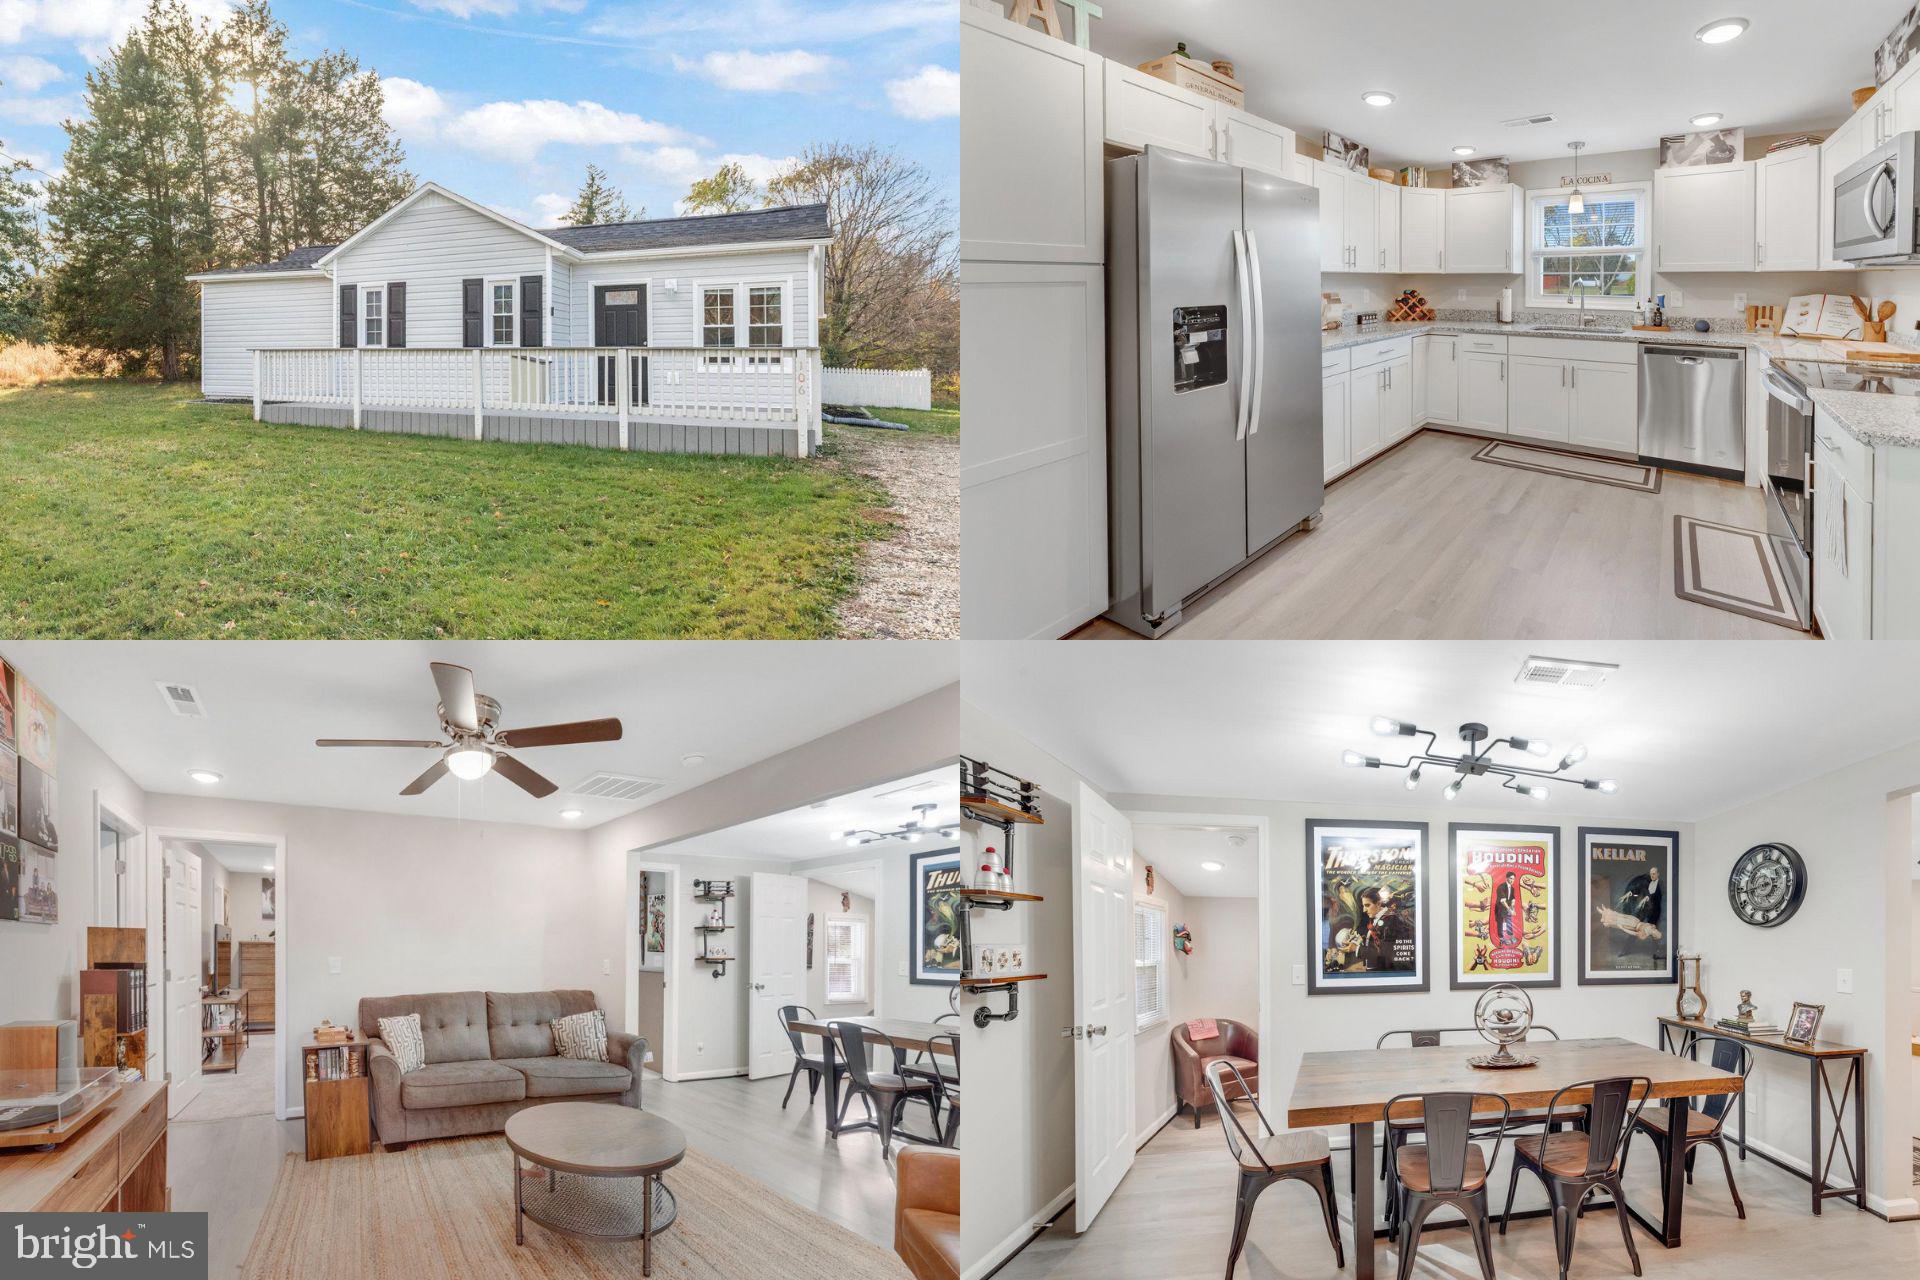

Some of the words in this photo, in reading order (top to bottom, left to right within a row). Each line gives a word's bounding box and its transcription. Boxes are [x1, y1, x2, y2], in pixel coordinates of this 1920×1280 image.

[1186, 82, 1217, 98] GENERAL
[1563, 178, 1574, 186] LA
[1577, 175, 1609, 185] COCINA
[1472, 851, 1540, 864] HOUDINI
[1592, 847, 1647, 861] KELLAR
